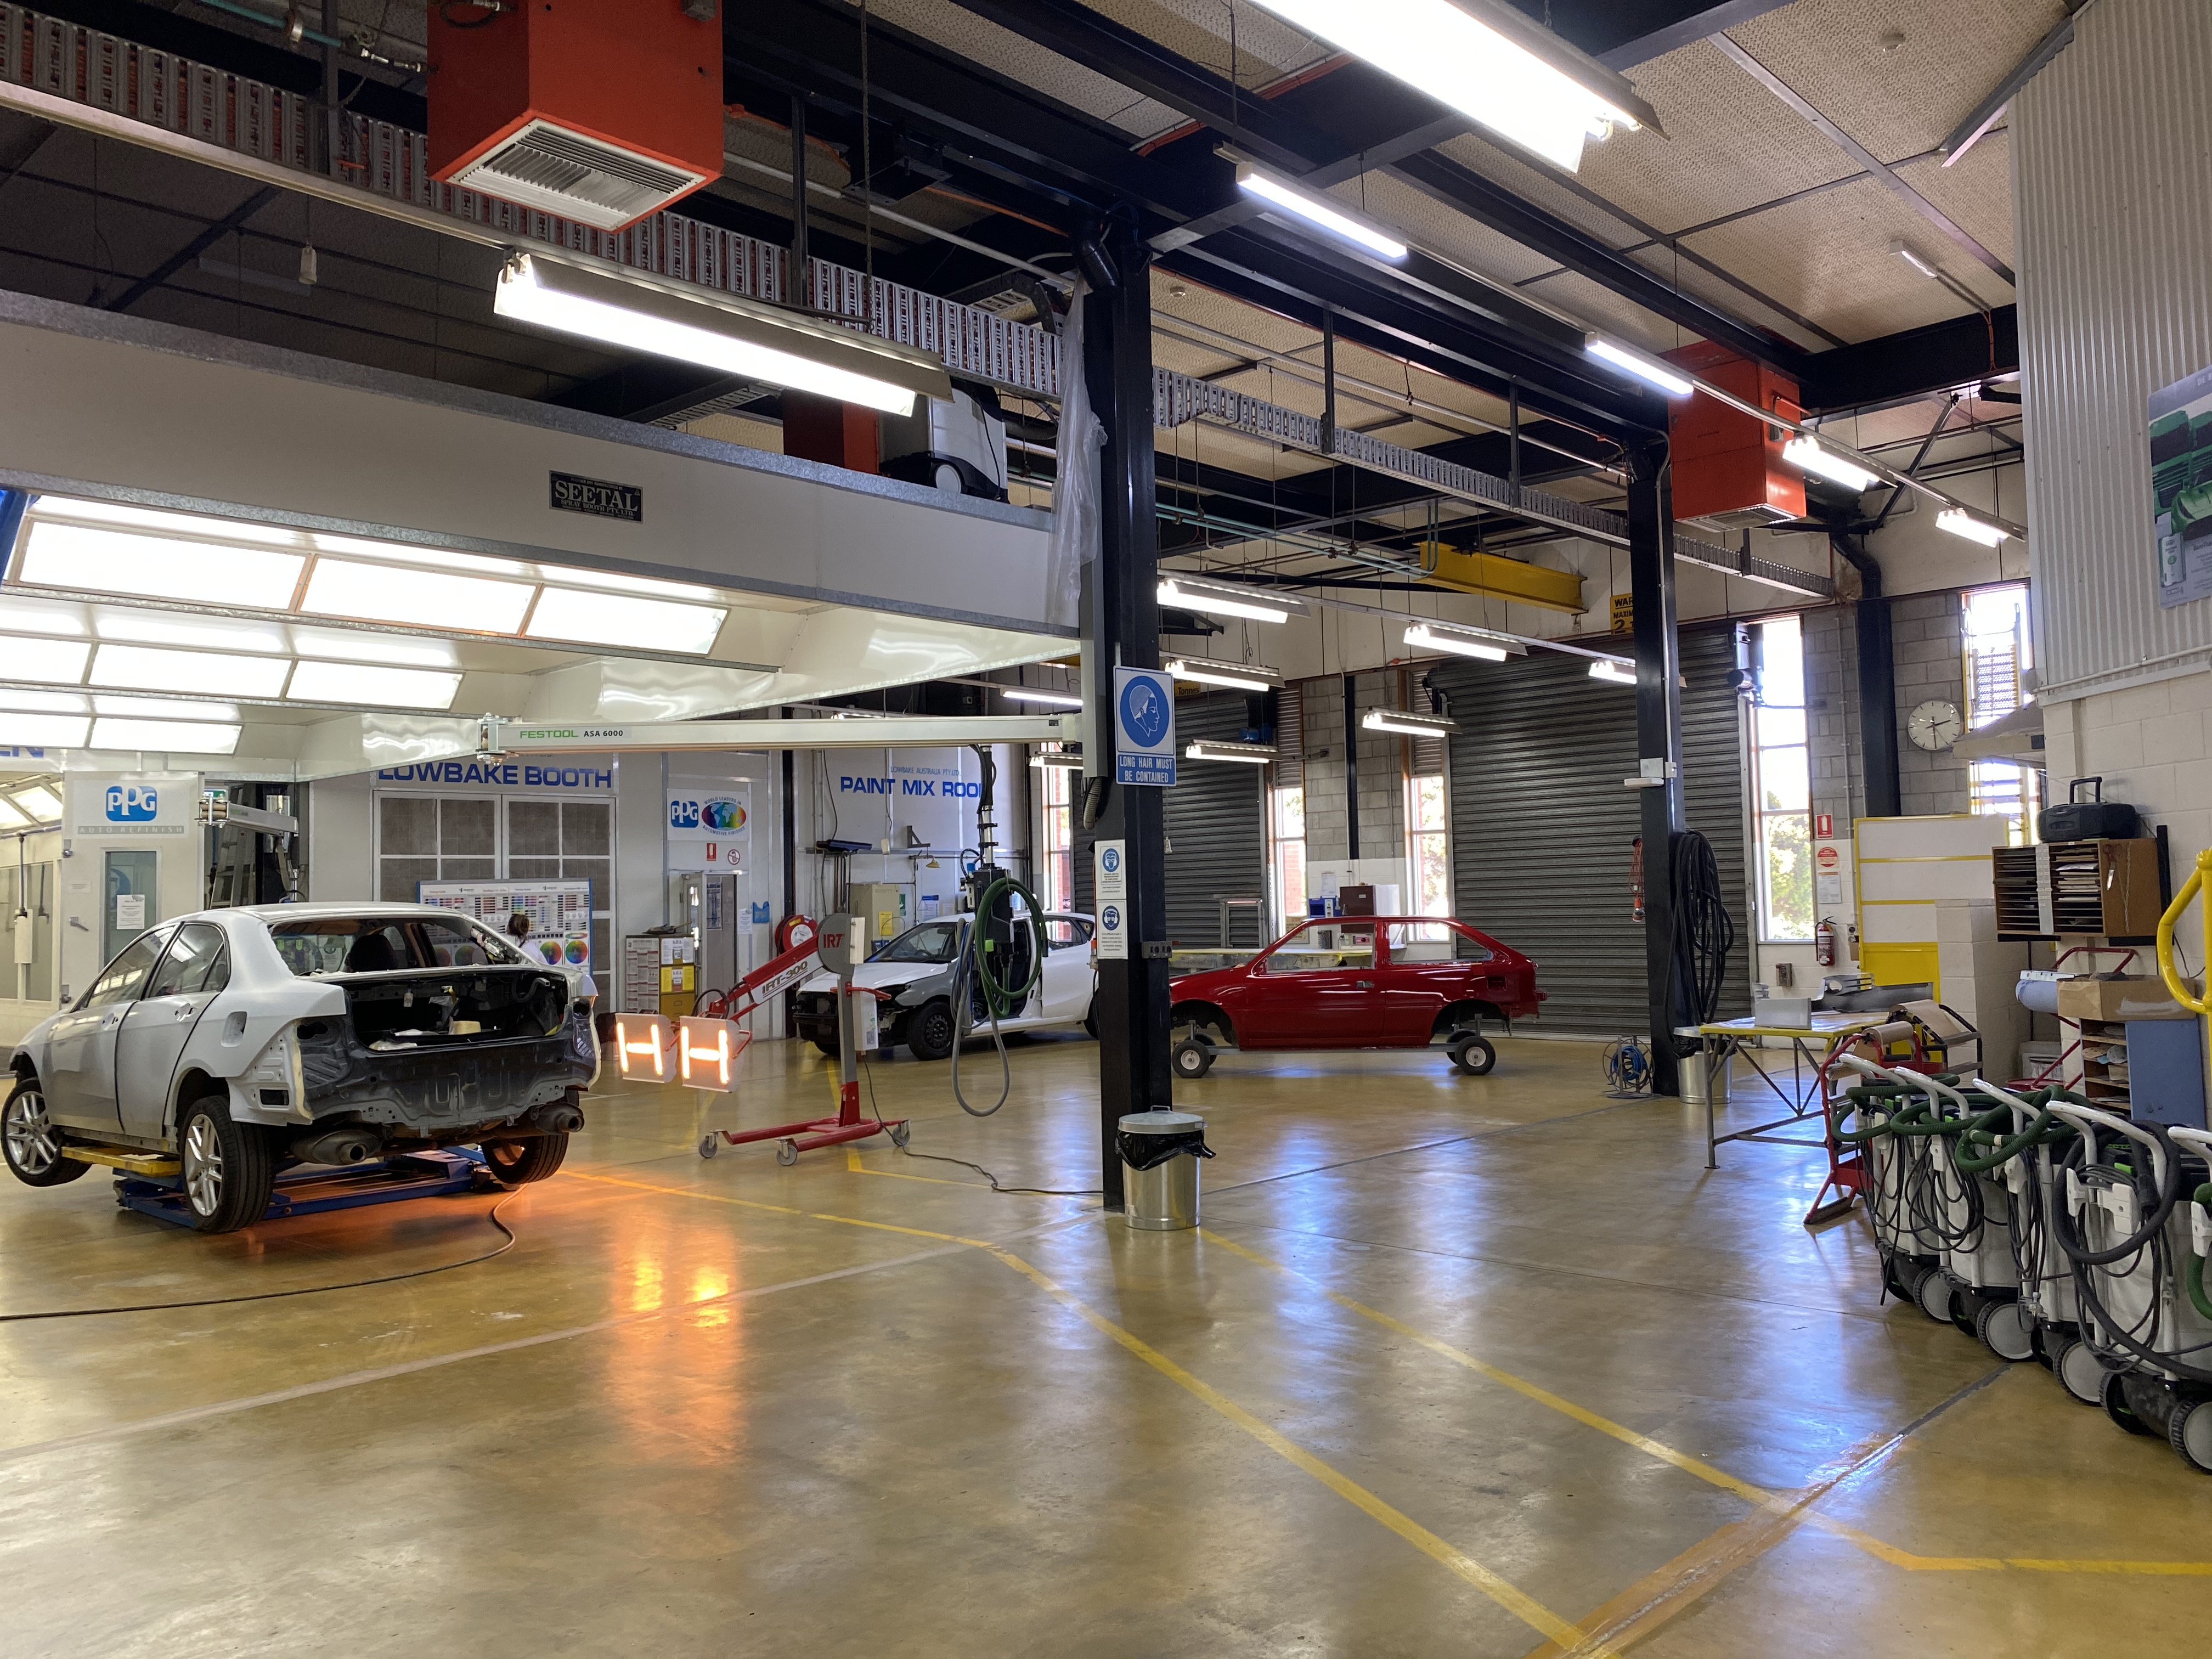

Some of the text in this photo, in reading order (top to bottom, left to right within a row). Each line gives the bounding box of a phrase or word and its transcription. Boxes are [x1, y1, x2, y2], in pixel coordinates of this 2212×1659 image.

[555, 480, 639, 512] SEETAL
[583, 503, 605, 511] BOOTH
[1614, 619, 1626, 634] 2
[1177, 686, 1199, 696] Tonnes
[520, 729, 623, 739] FESTOOL ASA 6000
[890, 766, 915, 774] LOWBAKE
[1120, 755, 1172, 770] LONG HAIR MUST
[524, 766, 612, 788] BOOTH
[1125, 770, 1169, 783] BE CONTAINED
[840, 776, 981, 798] PAINT MIX ROO
[108, 786, 156, 816] PPG
[704, 797, 718, 805] WORLD
[672, 800, 698, 823] PPG
[702, 825, 727, 836] AUTOMOTIVE
[823, 933, 844, 949] IRT
[762, 961, 808, 994] IRT-300
